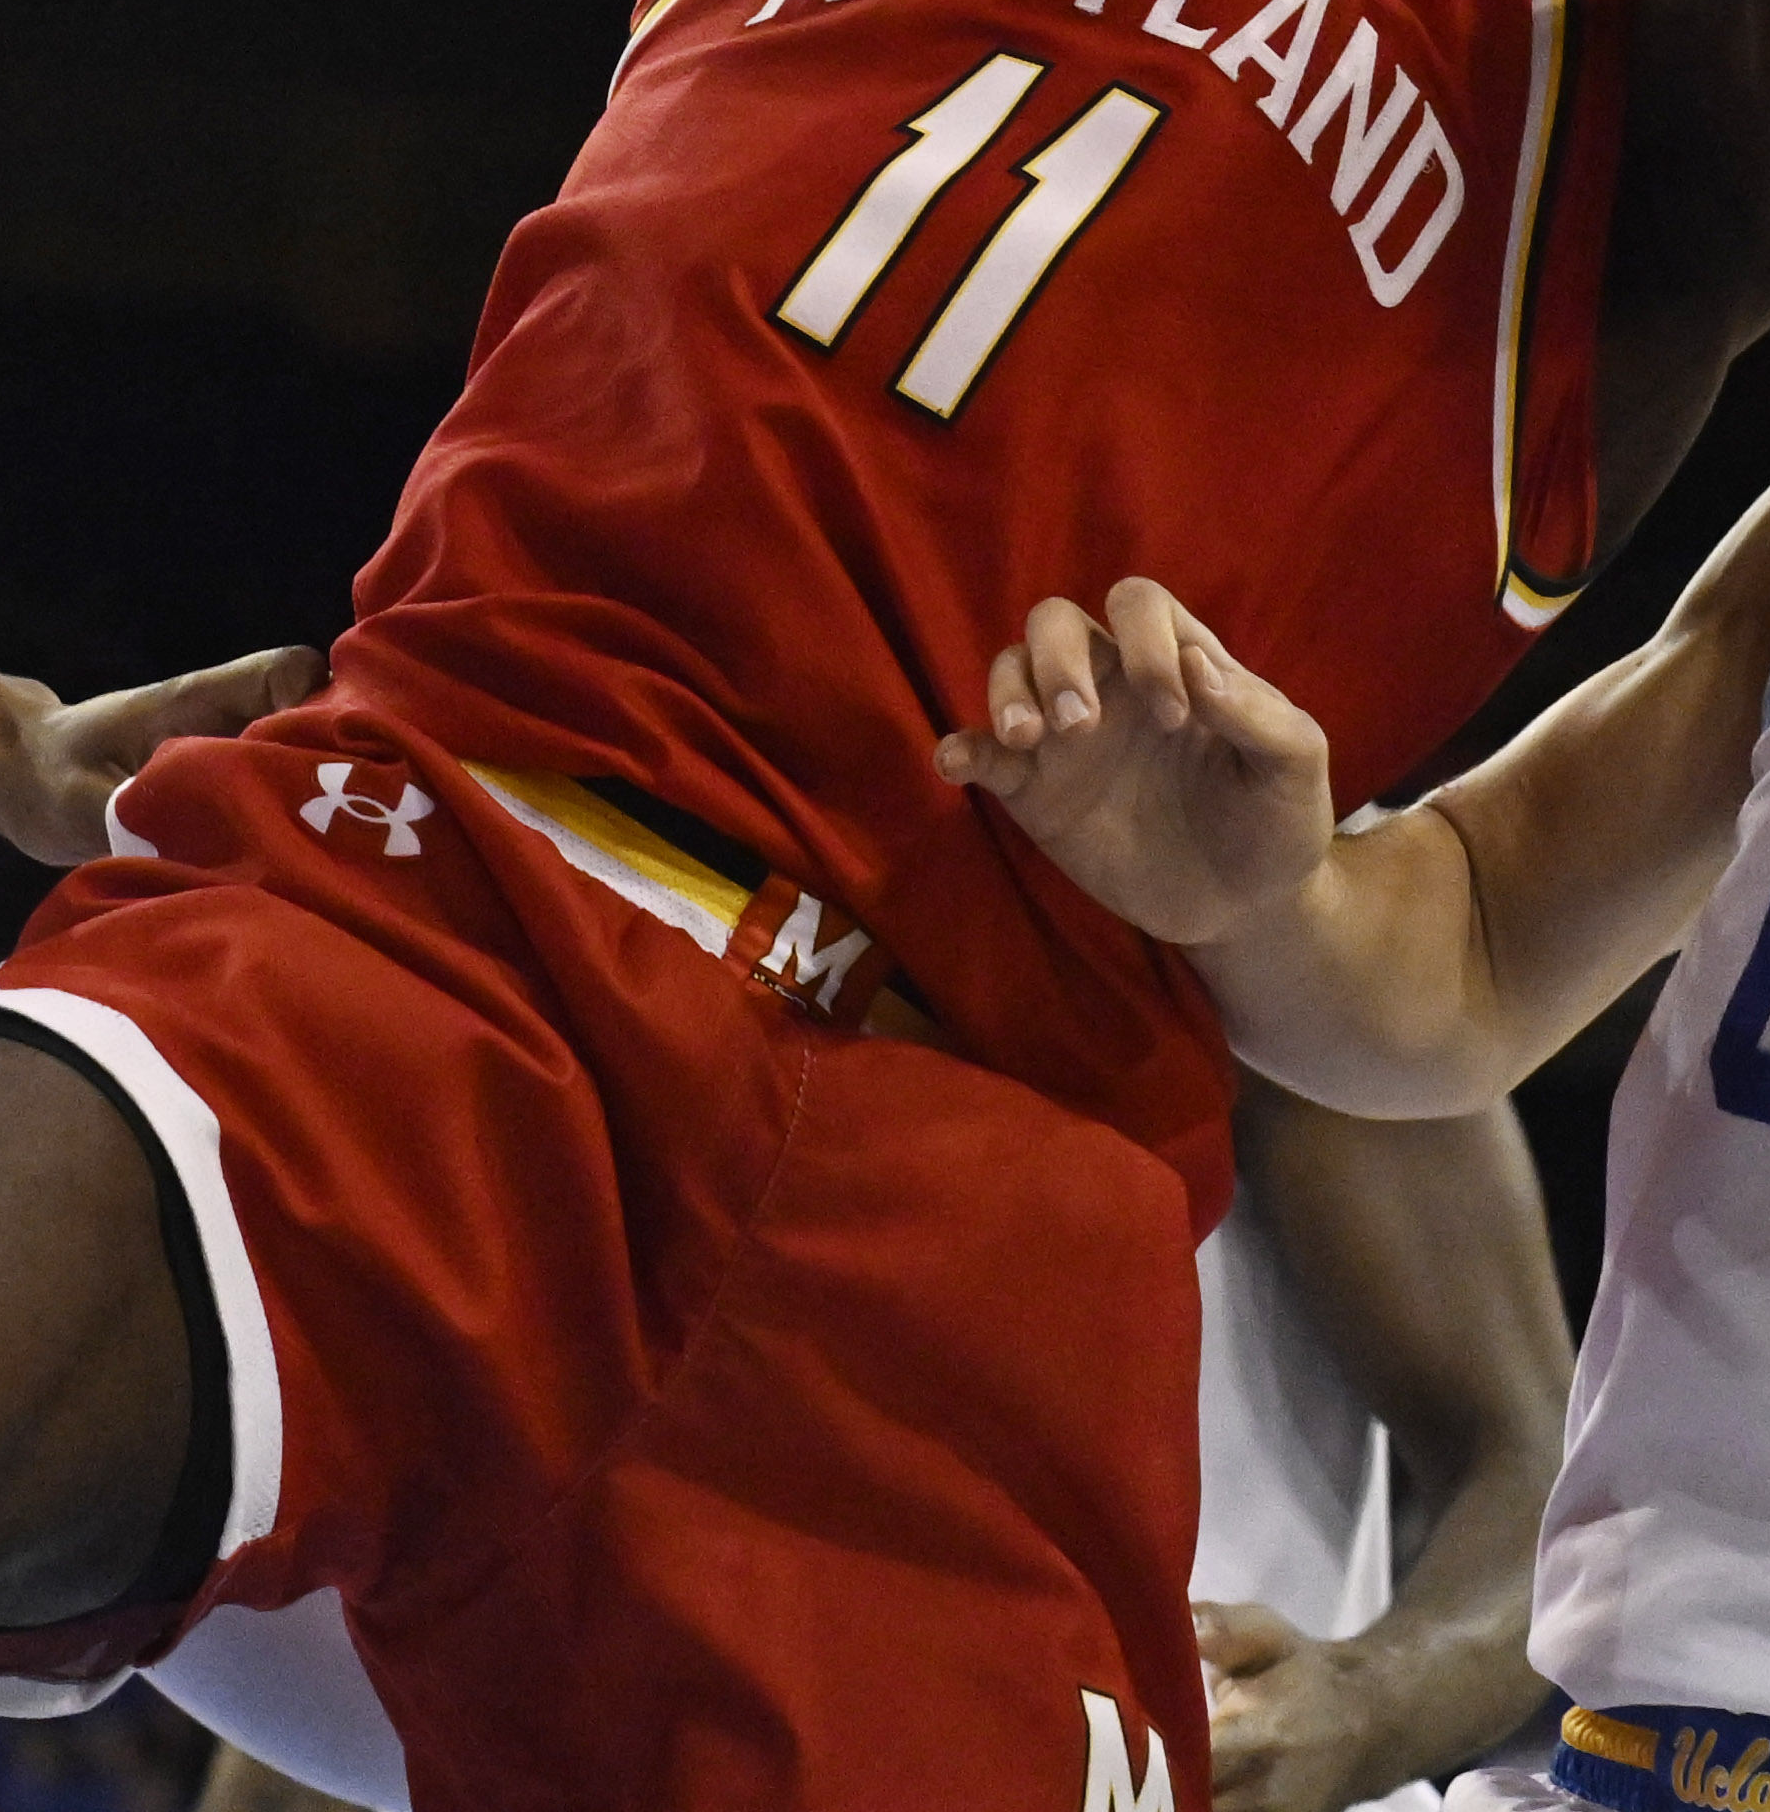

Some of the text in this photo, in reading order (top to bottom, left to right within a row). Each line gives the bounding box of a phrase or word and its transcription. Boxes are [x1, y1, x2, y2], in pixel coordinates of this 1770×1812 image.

[767, 44, 1171, 428] 11
[757, 890, 873, 1015] M
[1079, 1685, 1176, 1812] M
